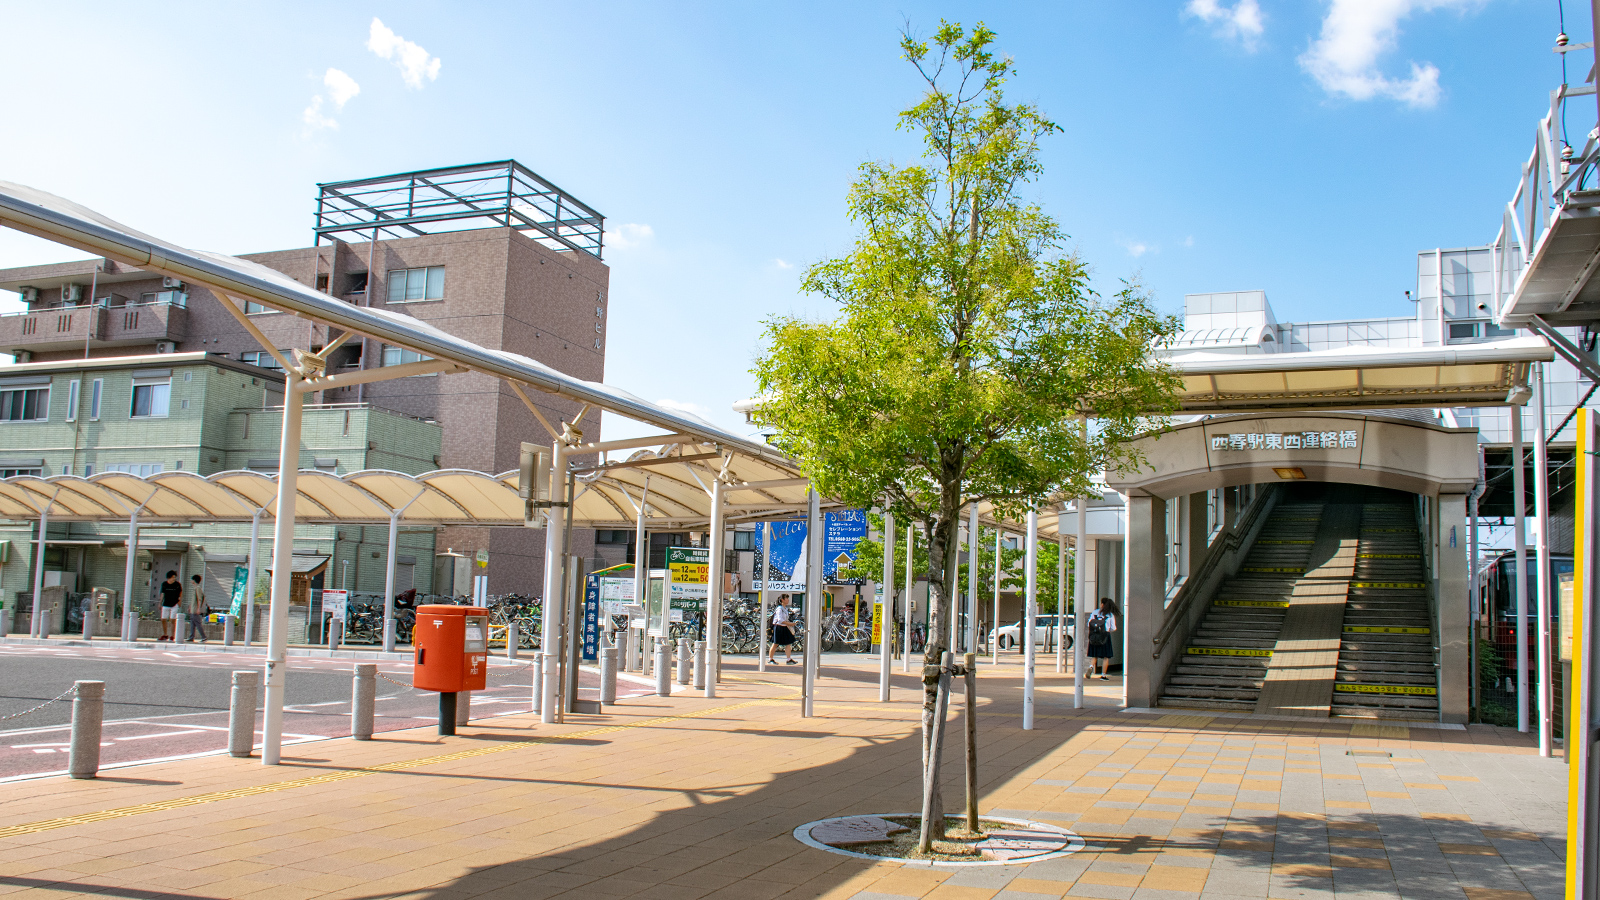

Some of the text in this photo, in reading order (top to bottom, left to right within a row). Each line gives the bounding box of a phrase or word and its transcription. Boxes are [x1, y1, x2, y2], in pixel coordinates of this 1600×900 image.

[1211, 430, 1357, 450] 西春駅東西連絡橋
[586, 591, 597, 654] 身障者乗降場
